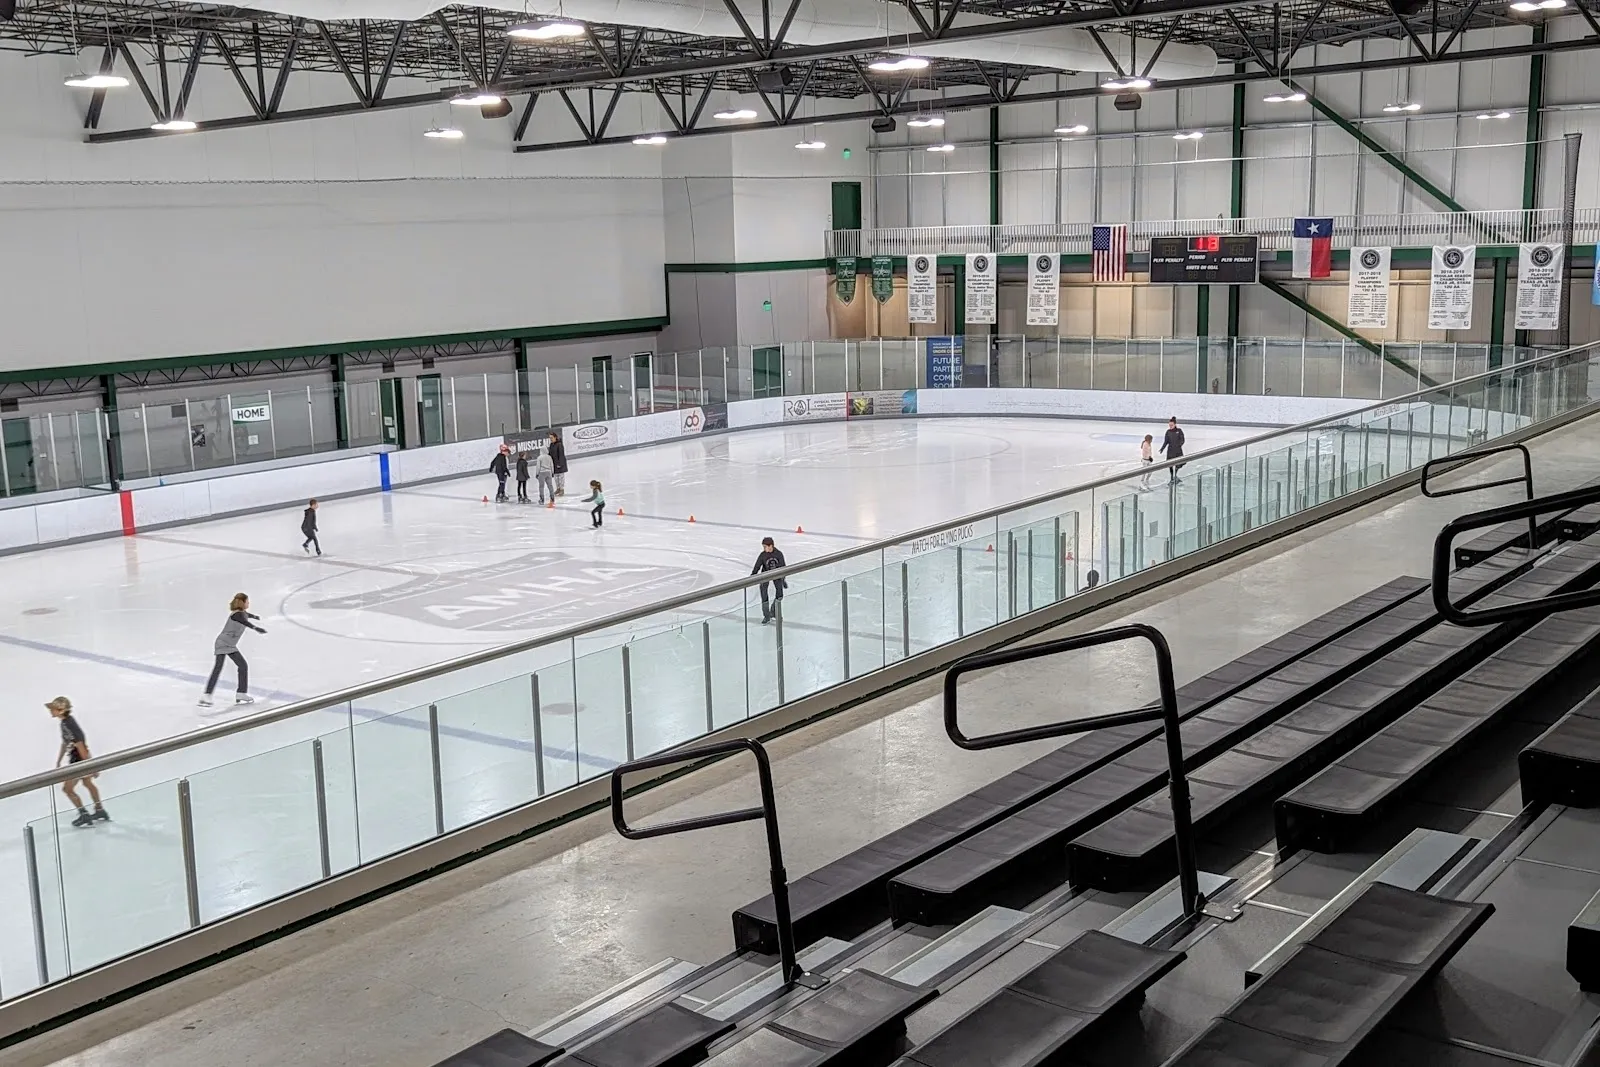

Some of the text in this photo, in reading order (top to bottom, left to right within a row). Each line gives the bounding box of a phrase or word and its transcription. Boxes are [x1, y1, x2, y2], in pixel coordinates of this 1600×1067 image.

[237, 408, 264, 419] HOME
[518, 439, 542, 452] MUSCLE
[930, 534, 939, 548] FOR
[940, 530, 957, 546] FLYING
[958, 524, 973, 540] PUCKS
[424, 566, 661, 621] AMHA
